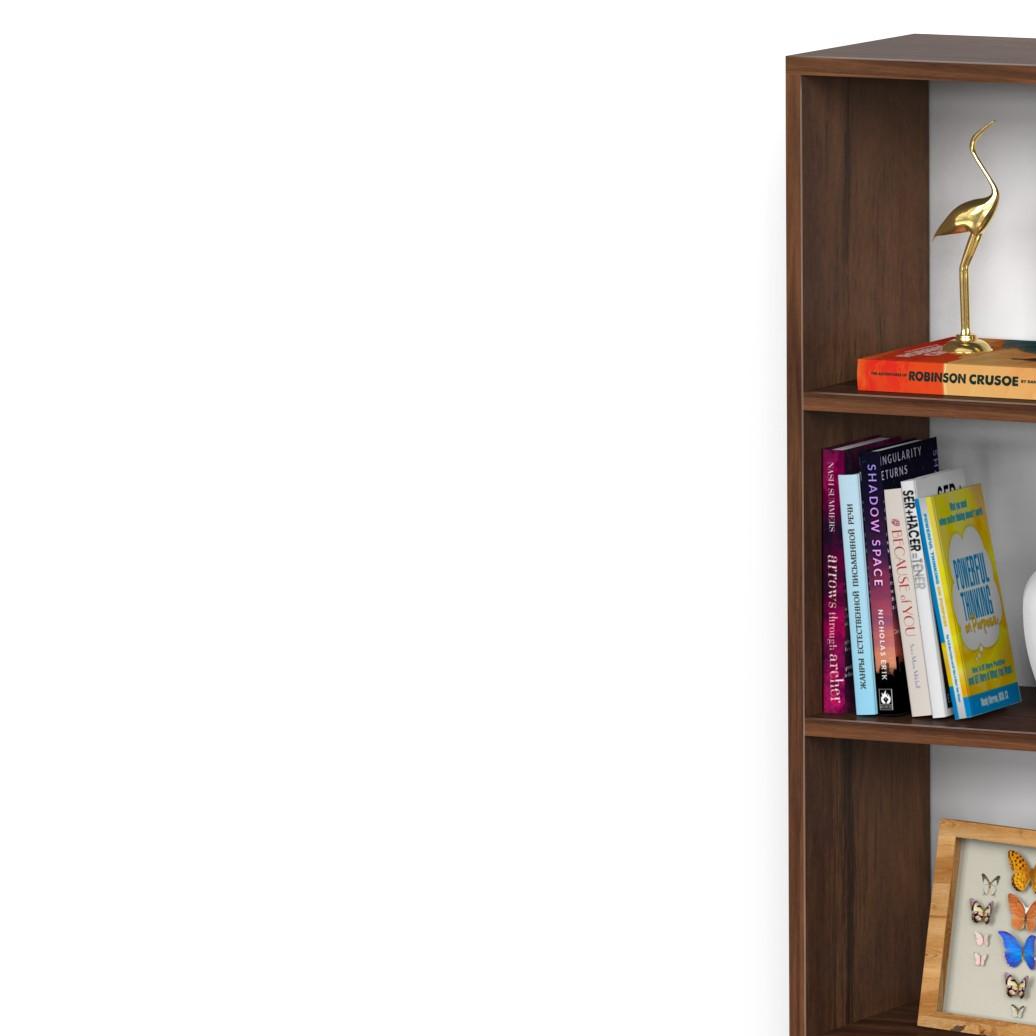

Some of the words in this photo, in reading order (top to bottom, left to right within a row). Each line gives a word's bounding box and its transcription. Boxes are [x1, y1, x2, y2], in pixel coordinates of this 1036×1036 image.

[908, 370, 966, 385] ROBINSON
[969, 374, 1019, 387] CRUSOE
[827, 488, 836, 533] SUMMERS
[846, 504, 856, 526] РЕЧИ
[867, 463, 880, 533] SHADOW
[848, 529, 859, 587] ПИСЬМЕННОЙ
[871, 539, 883, 587] SPACE
[952, 552, 990, 591] POWERFUL
[827, 554, 840, 609] arrows
[852, 591, 864, 655] ЕСТЕСТВЕННОЙ
[901, 606, 916, 637] YOU
[960, 585, 994, 621] THINKING
[827, 612, 839, 650] through
[877, 609, 886, 660] NICHOLAS
[828, 653, 844, 703] archer
[857, 658, 867, 690] ЖАНРЫ
[880, 661, 888, 681] ERIK
